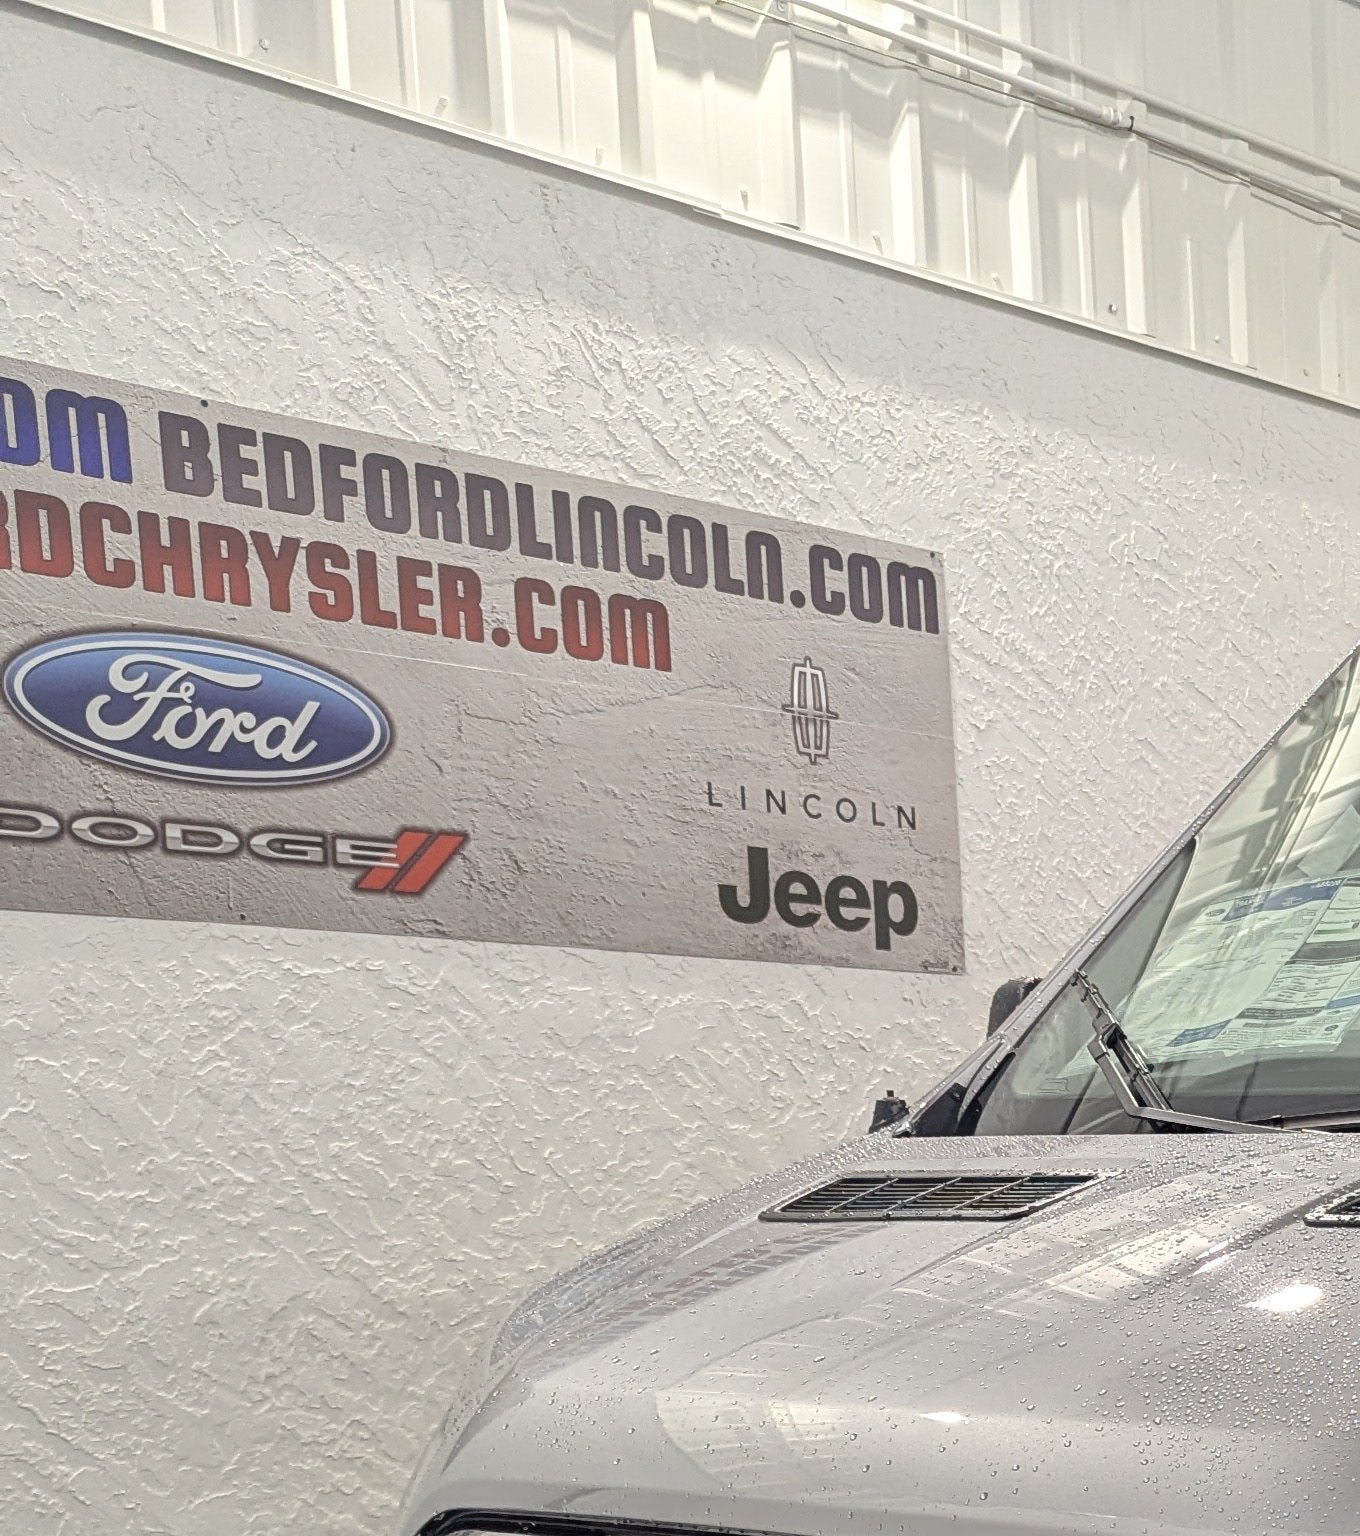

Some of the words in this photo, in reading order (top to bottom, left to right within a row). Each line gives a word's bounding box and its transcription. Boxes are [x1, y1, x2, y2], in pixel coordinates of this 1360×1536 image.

[0, 488, 672, 672] DCHRYSLER.COM
[85, 653, 321, 763] Ford
[707, 781, 916, 831] LINCOLN
[717, 845, 919, 952] Jeep
